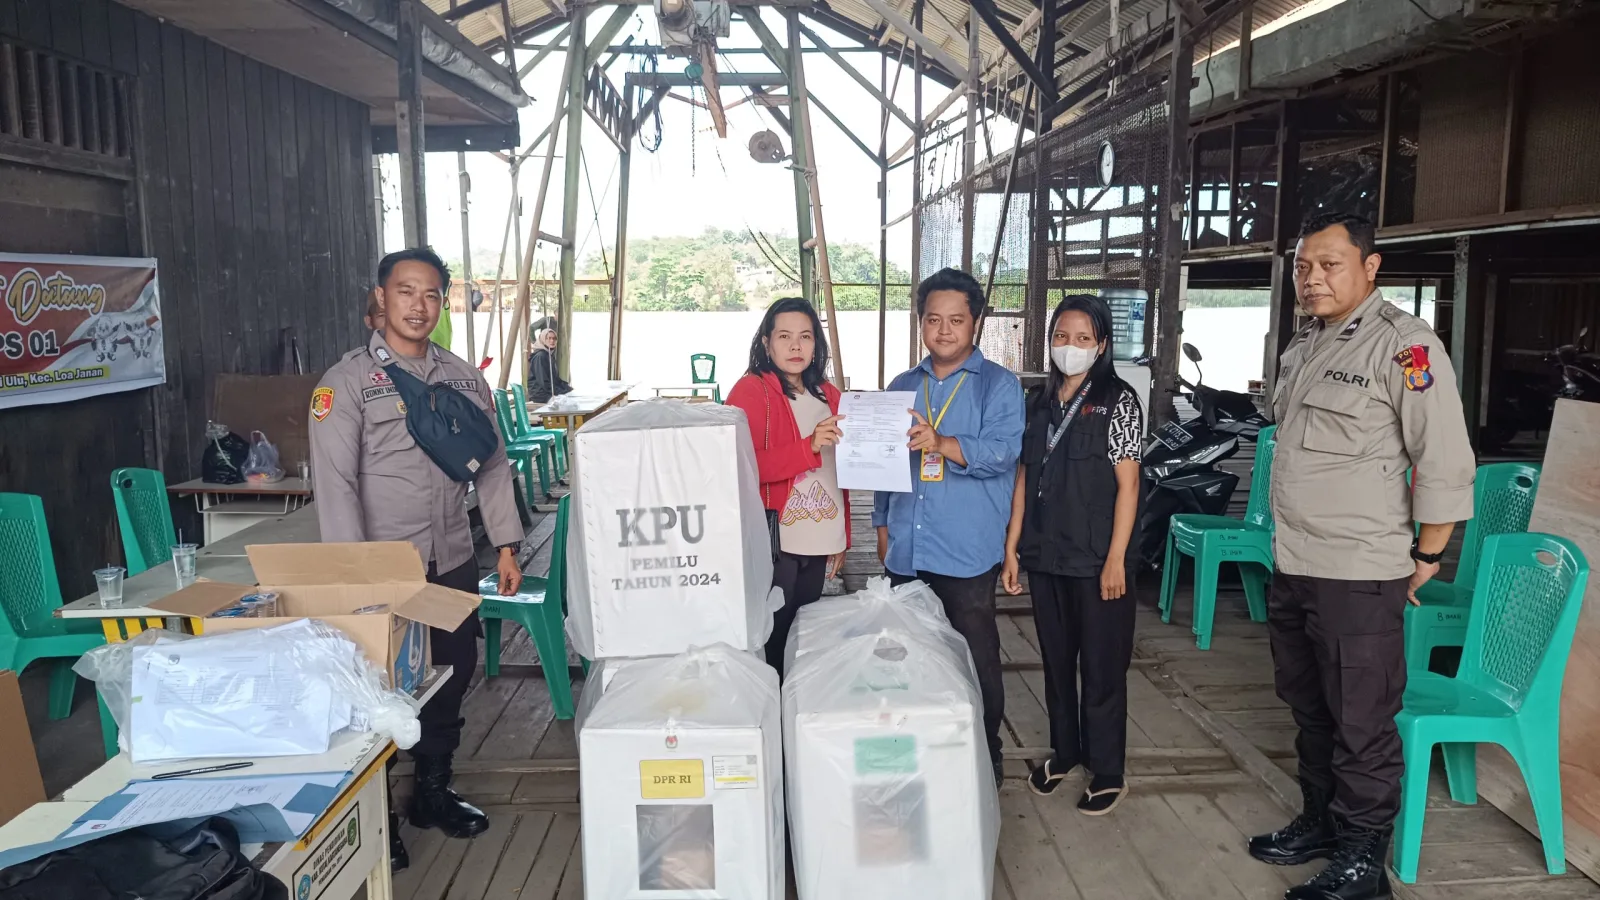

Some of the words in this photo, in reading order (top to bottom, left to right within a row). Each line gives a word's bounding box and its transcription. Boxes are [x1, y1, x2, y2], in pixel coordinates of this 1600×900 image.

[7, 268, 104, 323] Datang
[29, 330, 60, 357] 01
[5, 376, 28, 388] Ulu,
[29, 372, 53, 384] Kec.
[54, 370, 73, 381] Loa
[75, 367, 103, 379] Janan
[447, 381, 475, 390] POLRI
[1323, 369, 1371, 389] POLRI
[615, 504, 707, 548] KPU
[631, 555, 699, 572] PEMILU
[611, 574, 672, 591] TAHUN
[678, 572, 721, 588] 2024
[653, 775, 676, 784] DPR
[679, 774, 692, 784] RI
